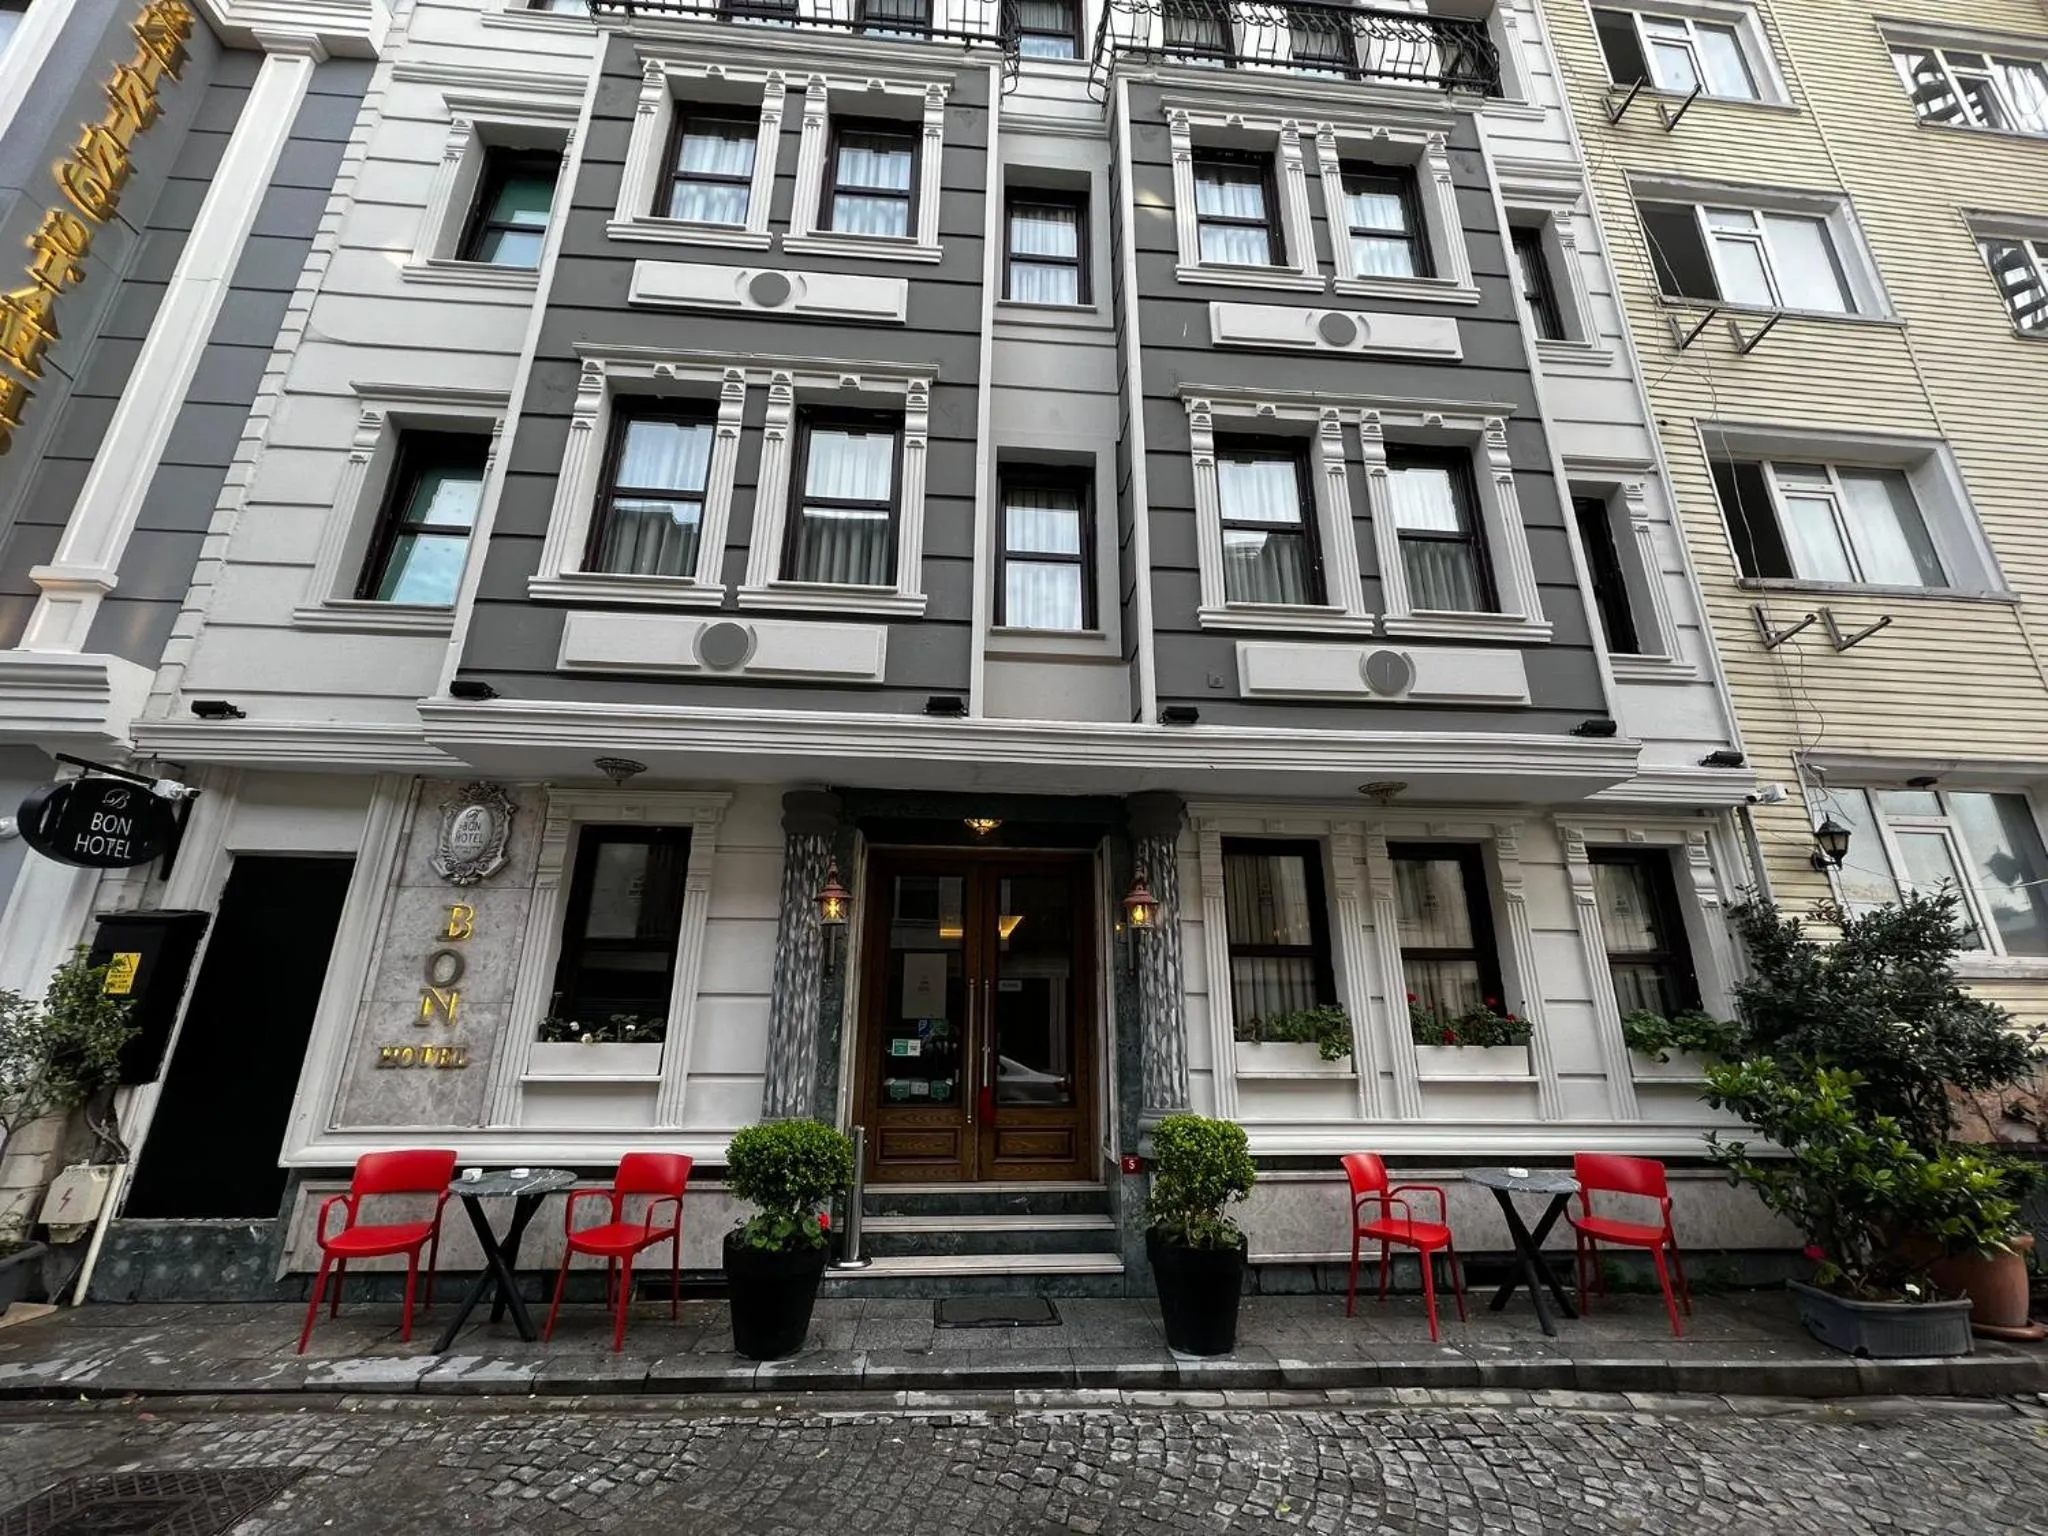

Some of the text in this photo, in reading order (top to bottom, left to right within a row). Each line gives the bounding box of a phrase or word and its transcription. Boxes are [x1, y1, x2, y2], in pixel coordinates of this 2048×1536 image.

[91, 812, 133, 836] BON
[74, 833, 131, 859] HOTEL
[415, 903, 476, 1027] BON
[375, 1046, 468, 1070] HOTEL
